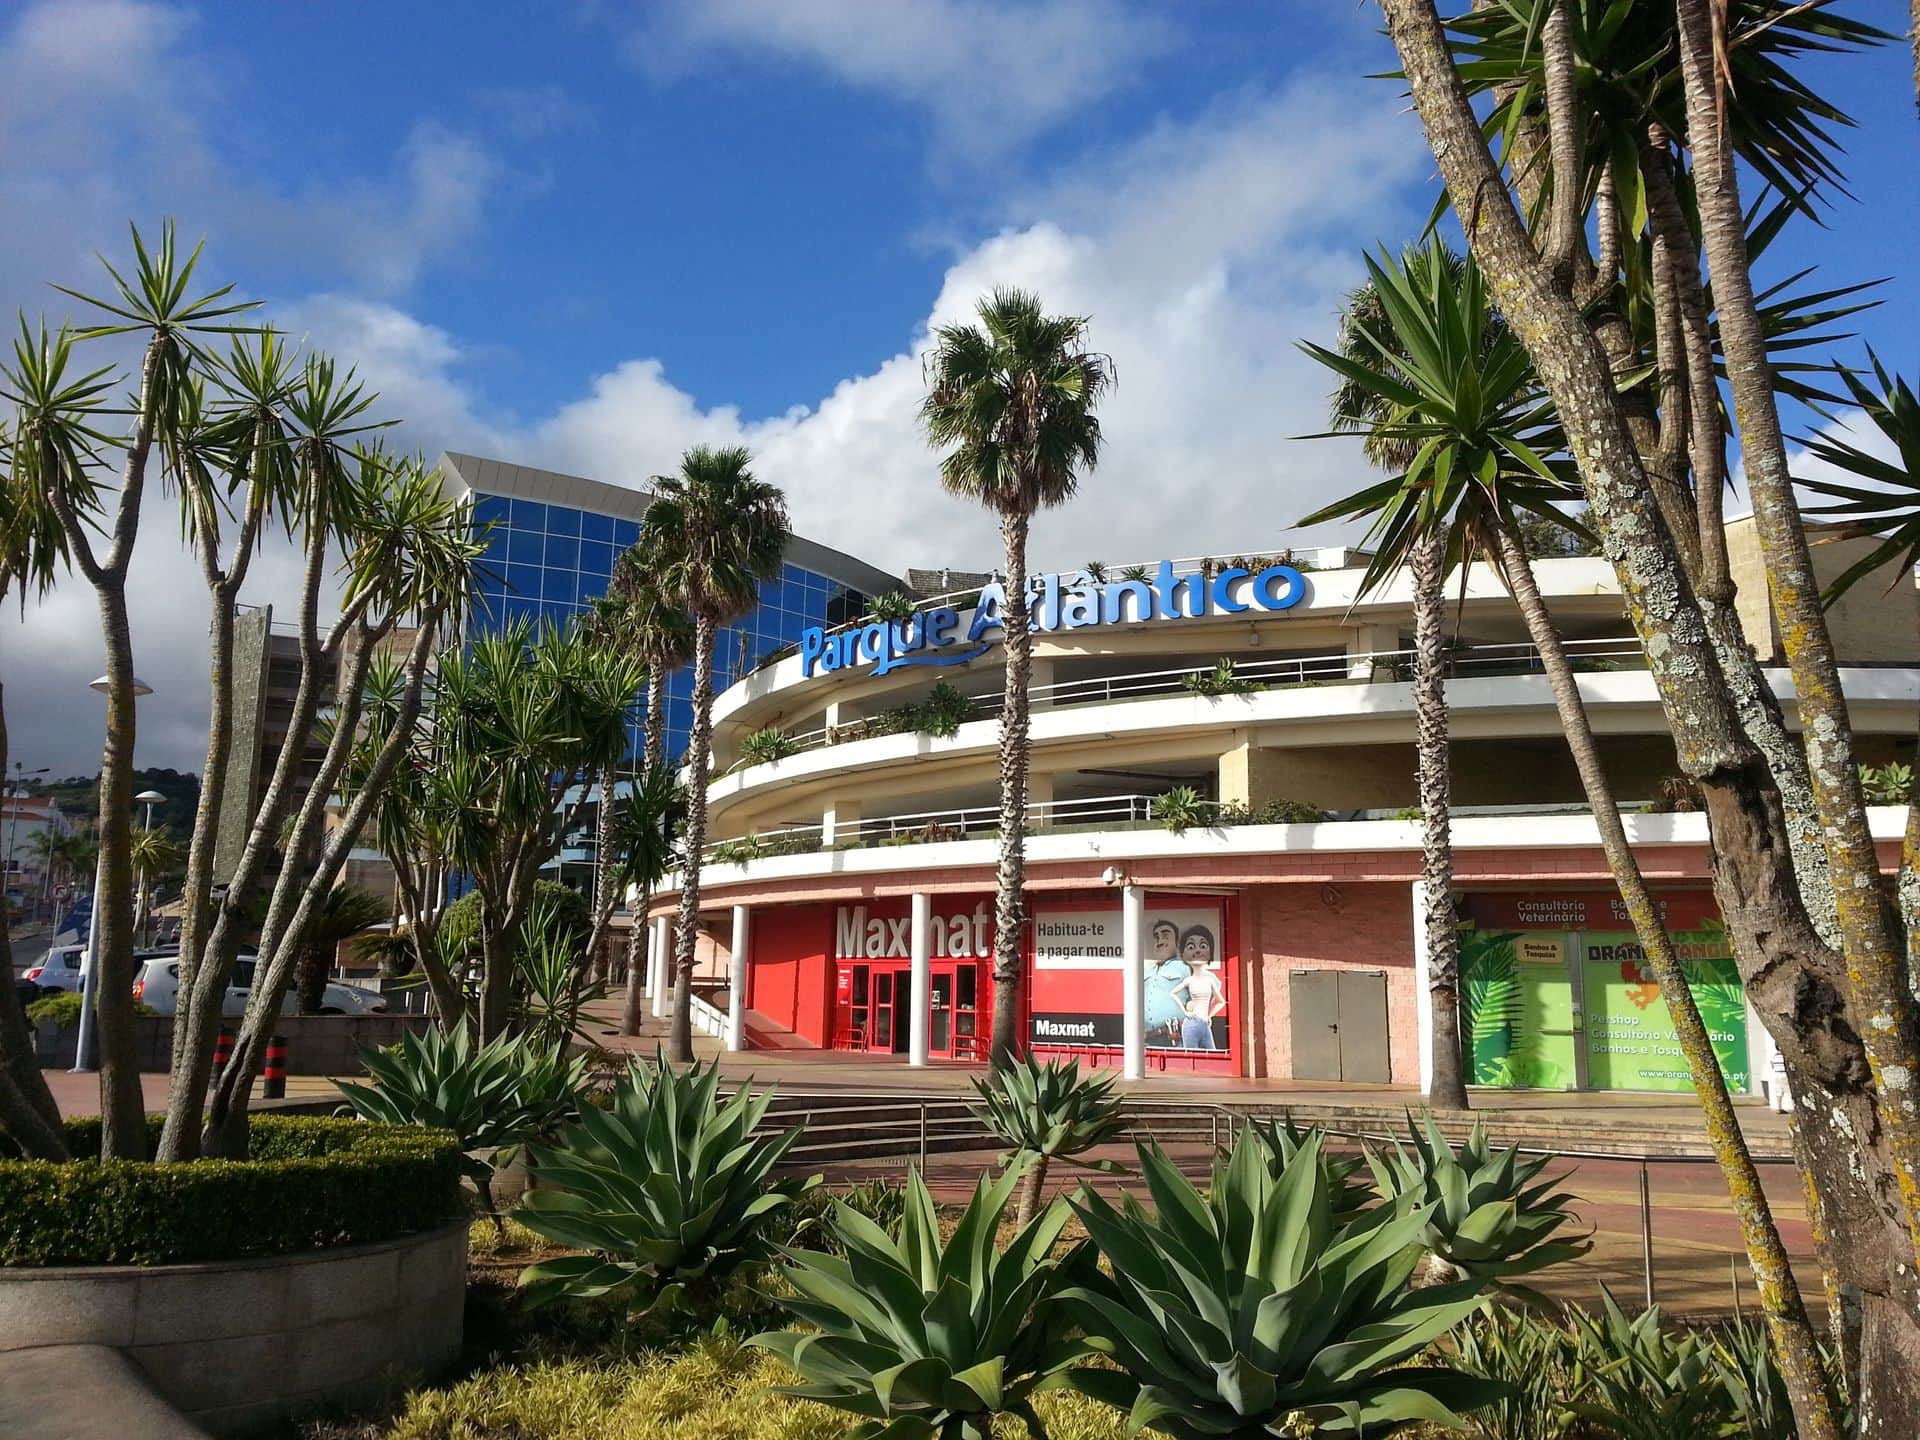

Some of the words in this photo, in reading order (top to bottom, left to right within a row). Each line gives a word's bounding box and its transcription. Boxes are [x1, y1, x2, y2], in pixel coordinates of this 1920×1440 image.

[801, 608, 959, 677] Parque
[1517, 900, 1585, 911] Consultório
[1518, 911, 1586, 922] Veterinário
[1037, 922, 1105, 937] Habitua-te
[1037, 946, 1045, 957] a
[1047, 946, 1084, 960] pagar
[1086, 946, 1123, 957] meno
[1035, 1019, 1096, 1037] Maxmat
